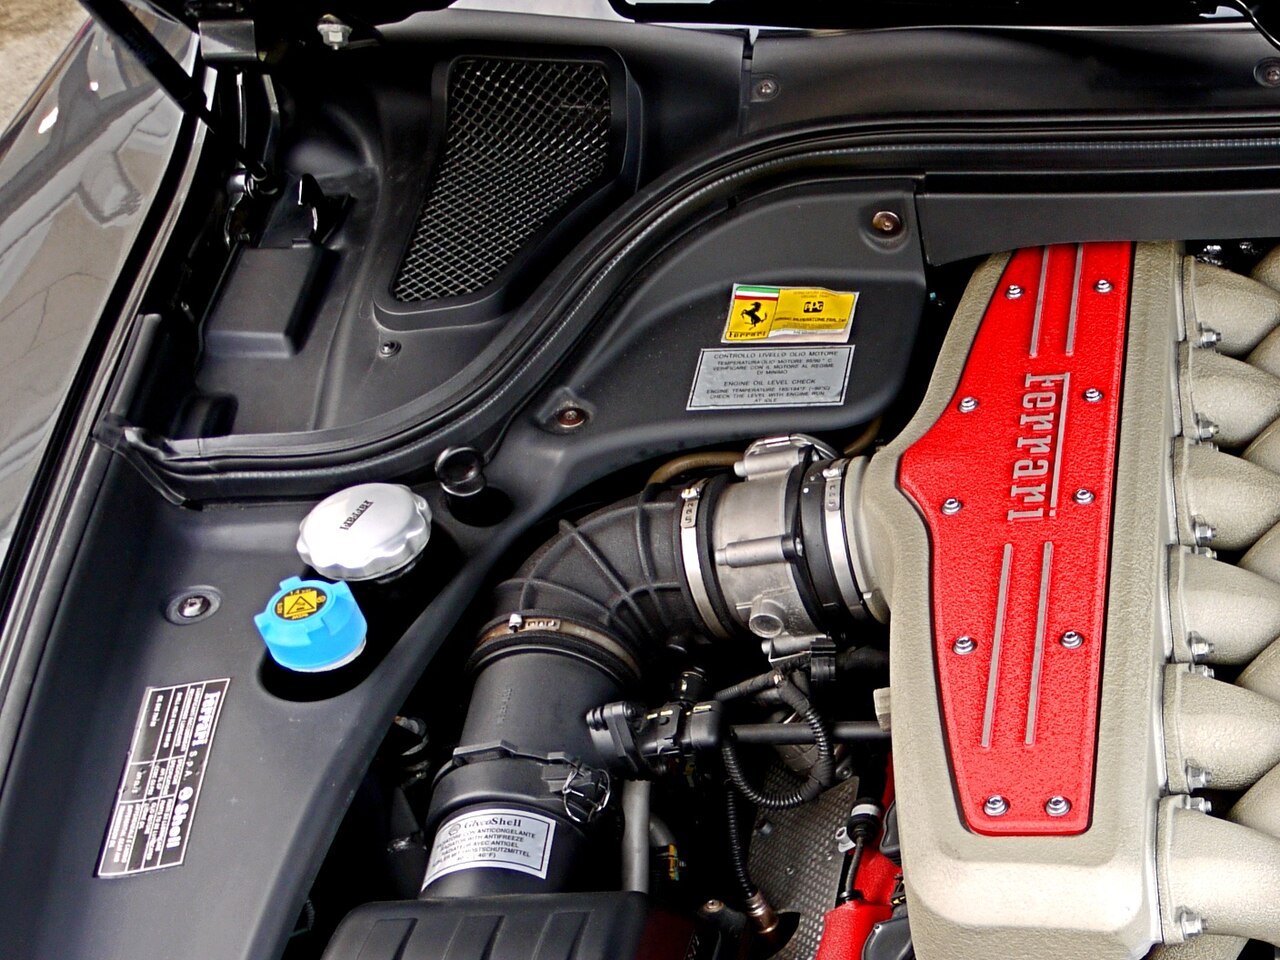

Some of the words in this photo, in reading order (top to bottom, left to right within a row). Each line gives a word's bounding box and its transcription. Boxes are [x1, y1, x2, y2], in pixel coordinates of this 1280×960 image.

[804, 301, 824, 313] PPG
[1007, 372, 1071, 522] Ferrari
[191, 691, 222, 747] Ferrari
[166, 803, 190, 849] Shell
[477, 827, 536, 838] ANTICONGELANTE
[484, 834, 524, 842] ANTIFREEZE
[490, 840, 520, 848] ANTIGEL
